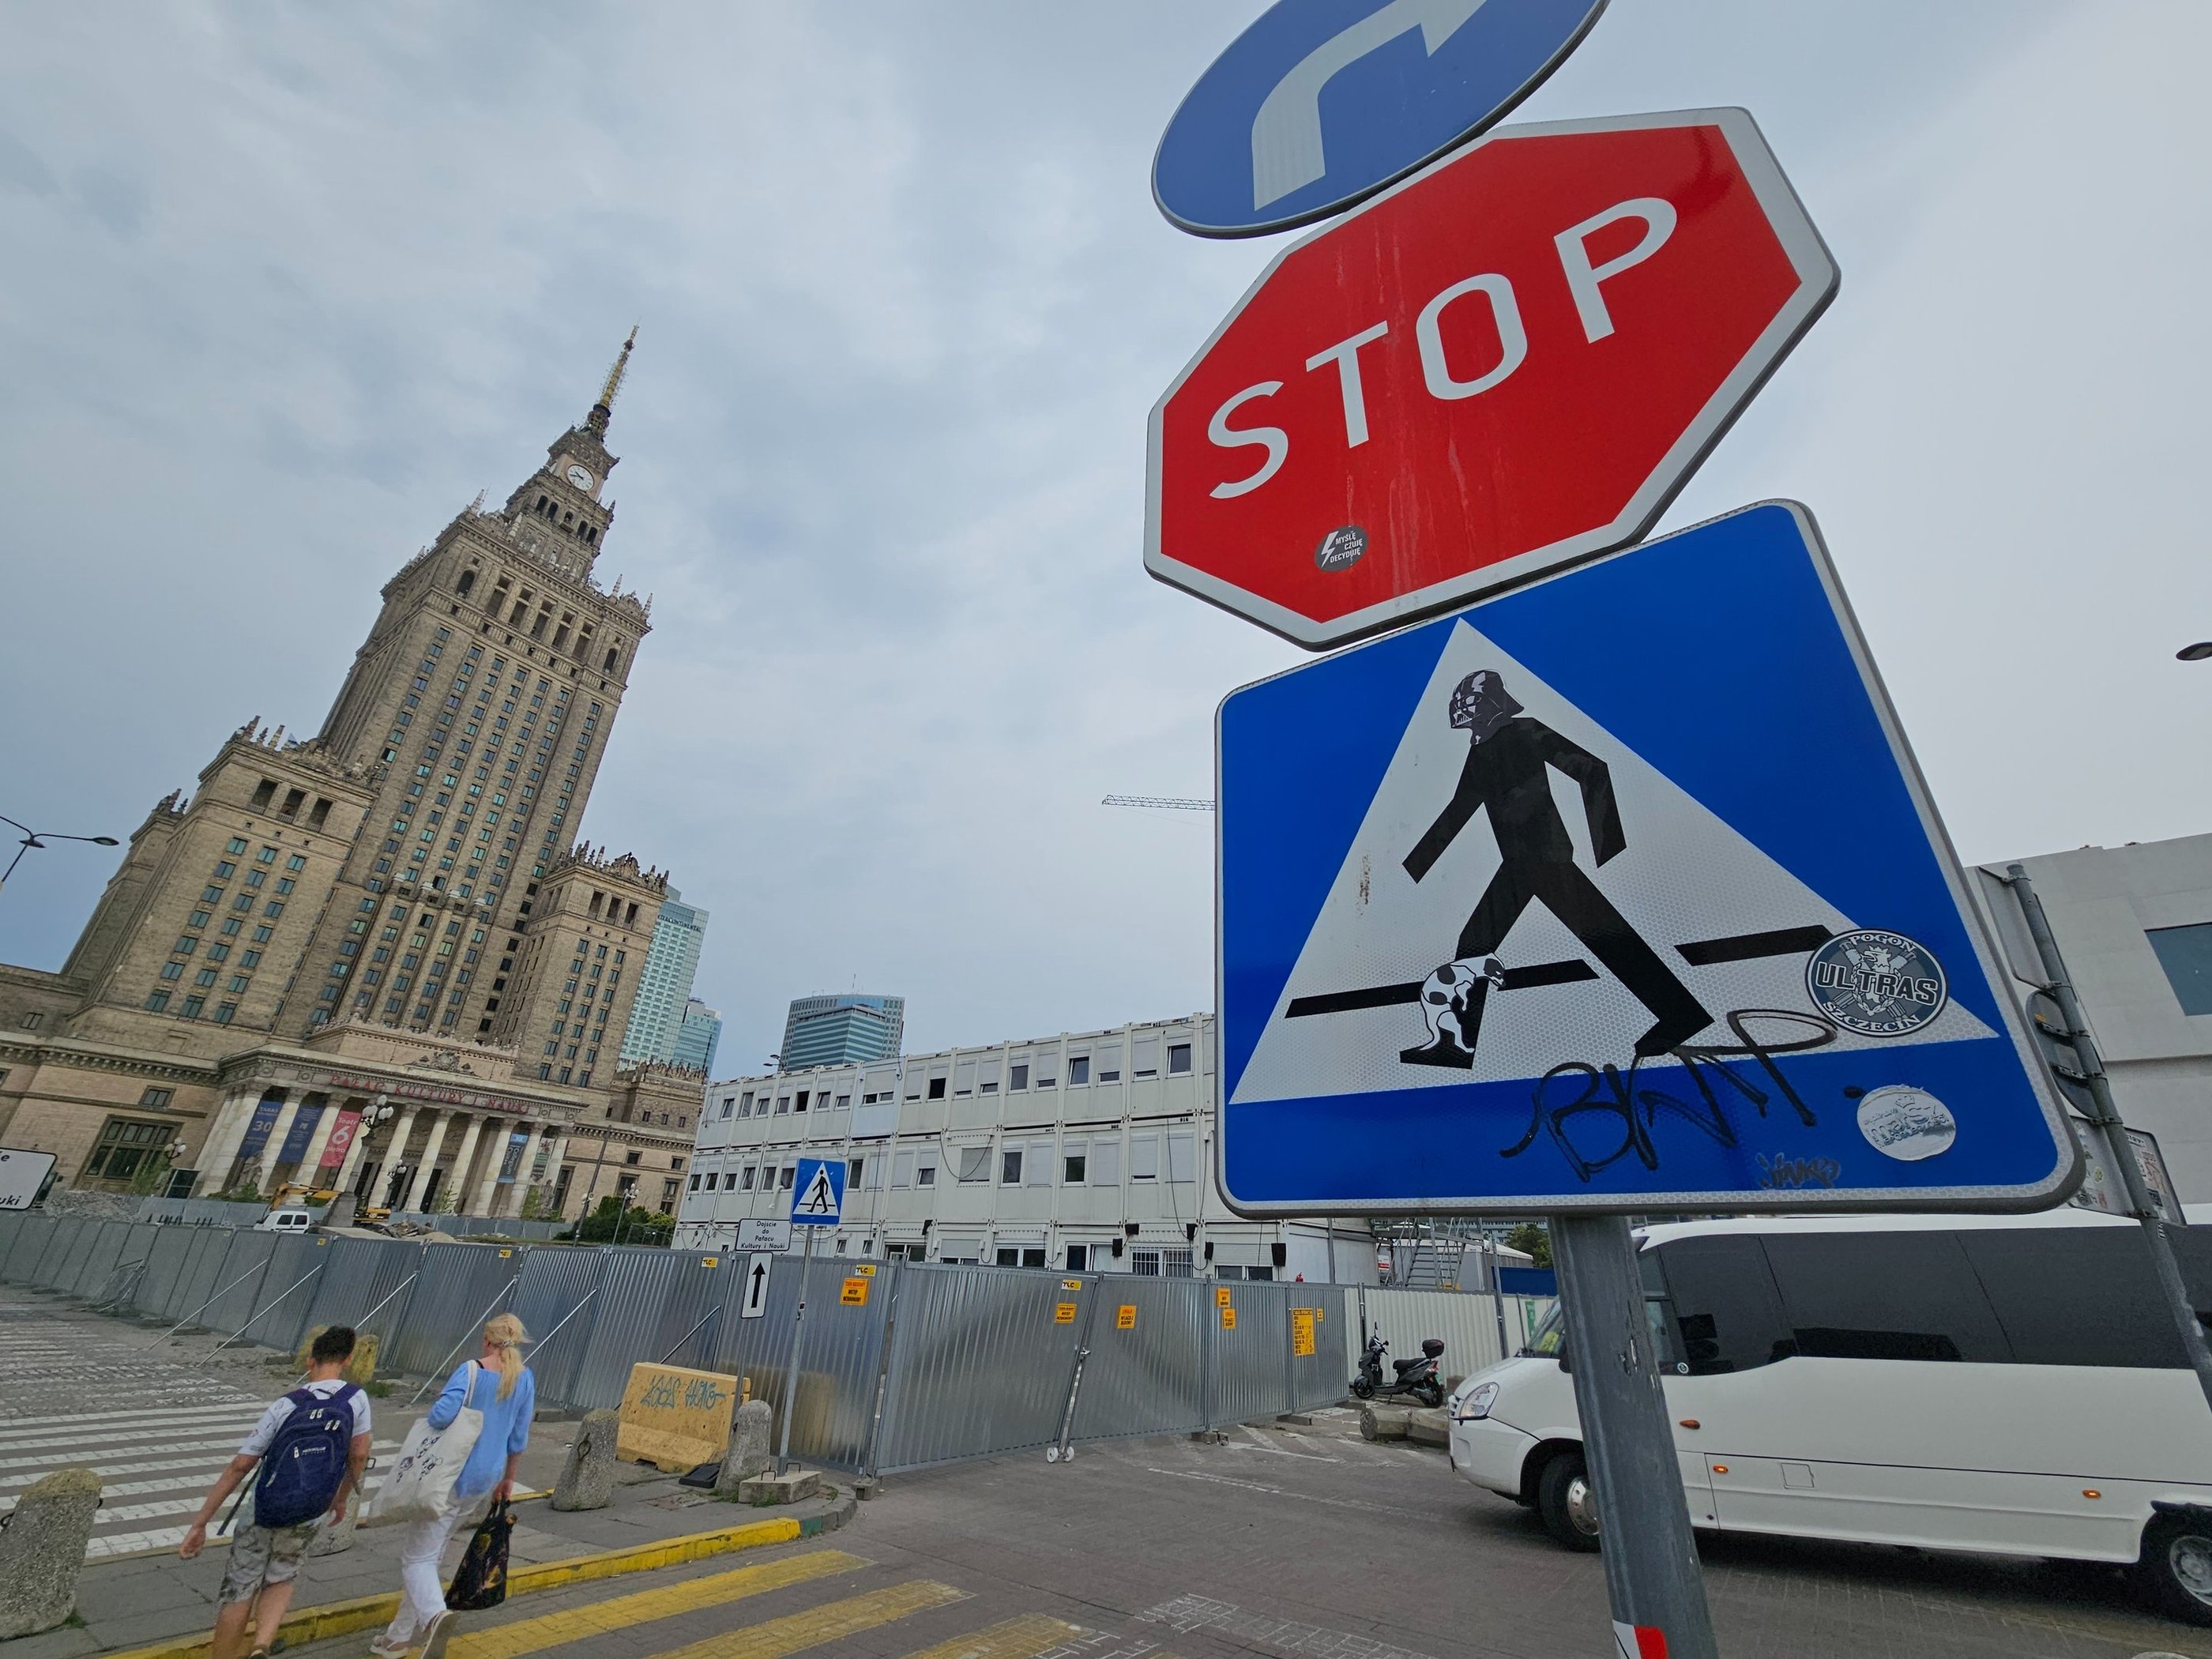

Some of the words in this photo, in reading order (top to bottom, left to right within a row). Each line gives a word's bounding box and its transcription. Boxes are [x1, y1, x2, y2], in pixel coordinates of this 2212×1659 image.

[1208, 197, 1678, 499] STOP
[1335, 532, 1356, 545] MYŚLĘ
[1345, 538, 1363, 551] CZUJĘ
[1330, 547, 1361, 563] DECYDUJĘ
[1815, 961, 1938, 1006] ULTRAS
[1822, 1000, 1921, 1032] SZCZECIN
[330, 1074, 386, 1092] PAŁAC
[394, 1084, 465, 1104] KULTURY
[252, 1120, 273, 1133] 30
[337, 1117, 358, 1126] Teatr
[332, 1126, 350, 1146] 6
